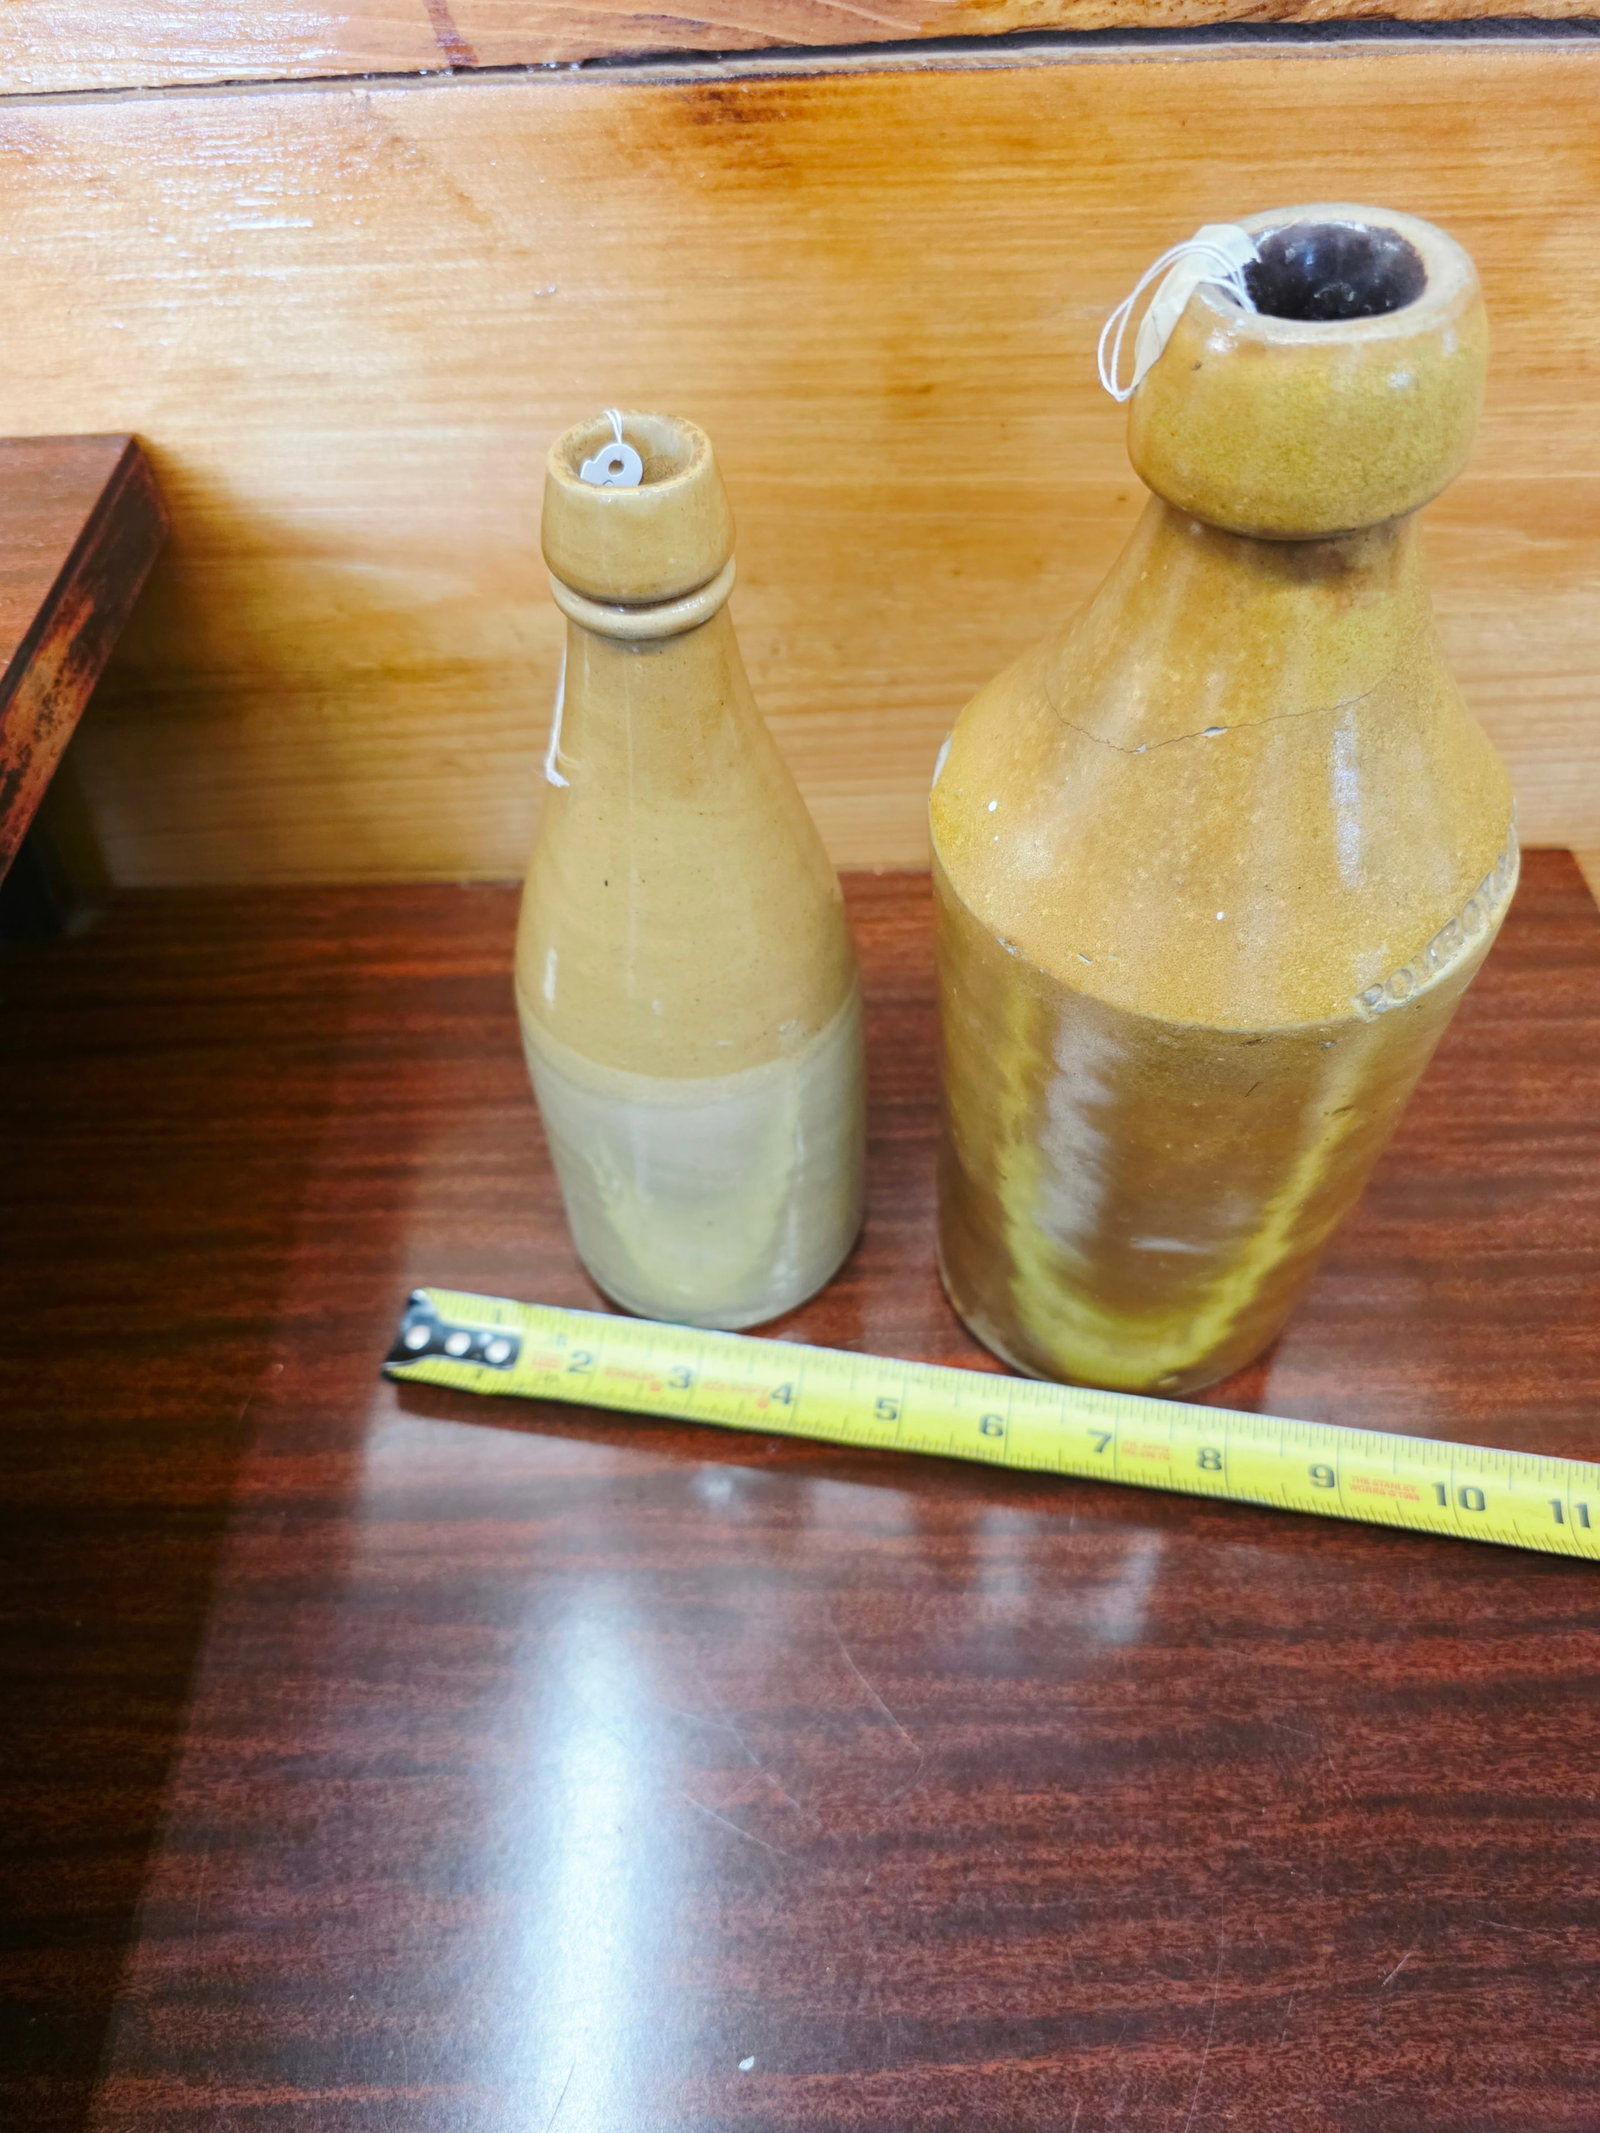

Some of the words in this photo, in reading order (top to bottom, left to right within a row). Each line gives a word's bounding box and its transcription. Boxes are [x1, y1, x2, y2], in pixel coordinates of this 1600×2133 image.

[567, 1350, 593, 1375] 2
[668, 1365, 692, 1390] 3
[770, 1382, 794, 1406] 4
[874, 1397, 898, 1421] 5
[980, 1414, 1004, 1438] 6
[1088, 1429, 1112, 1453] 7
[1197, 1447, 1223, 1471] 8
[1308, 1463, 1335, 1489] 9
[1432, 1482, 1486, 1512] 10
[1548, 1499, 1591, 1529] 11
[1372, 1478, 1417, 1493] STANLEY
